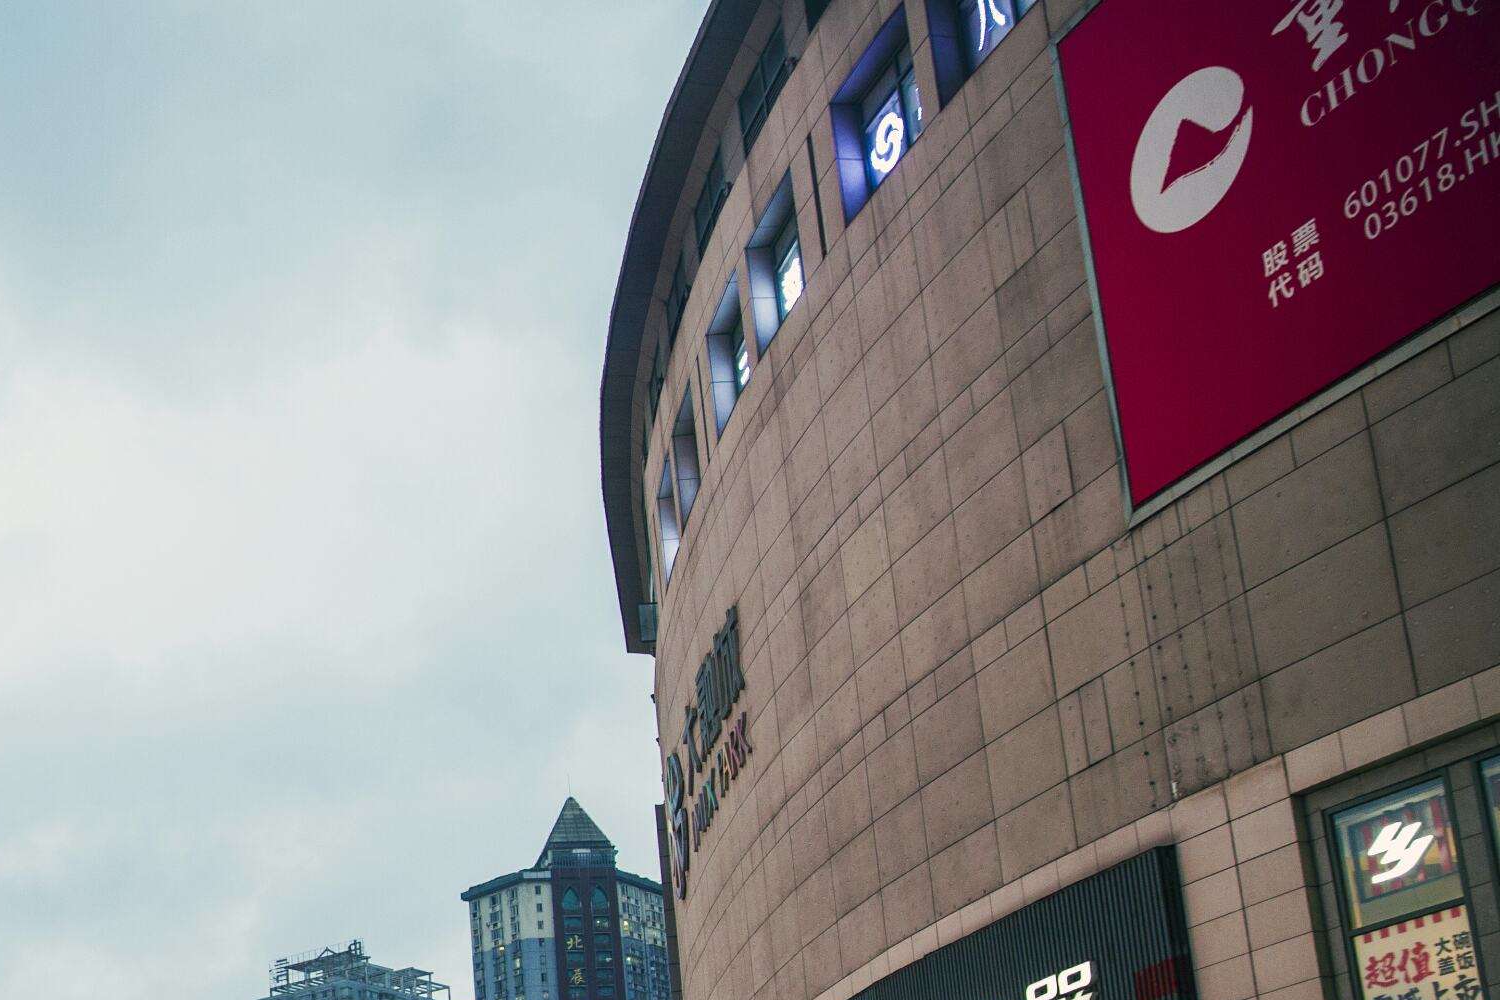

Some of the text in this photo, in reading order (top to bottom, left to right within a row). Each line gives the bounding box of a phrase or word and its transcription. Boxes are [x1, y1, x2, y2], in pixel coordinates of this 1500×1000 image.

[1262, 217, 1320, 277] 股票
[1267, 252, 1324, 308] 代码
[1364, 942, 1437, 990] 超值
[1435, 929, 1472, 954] 大碗
